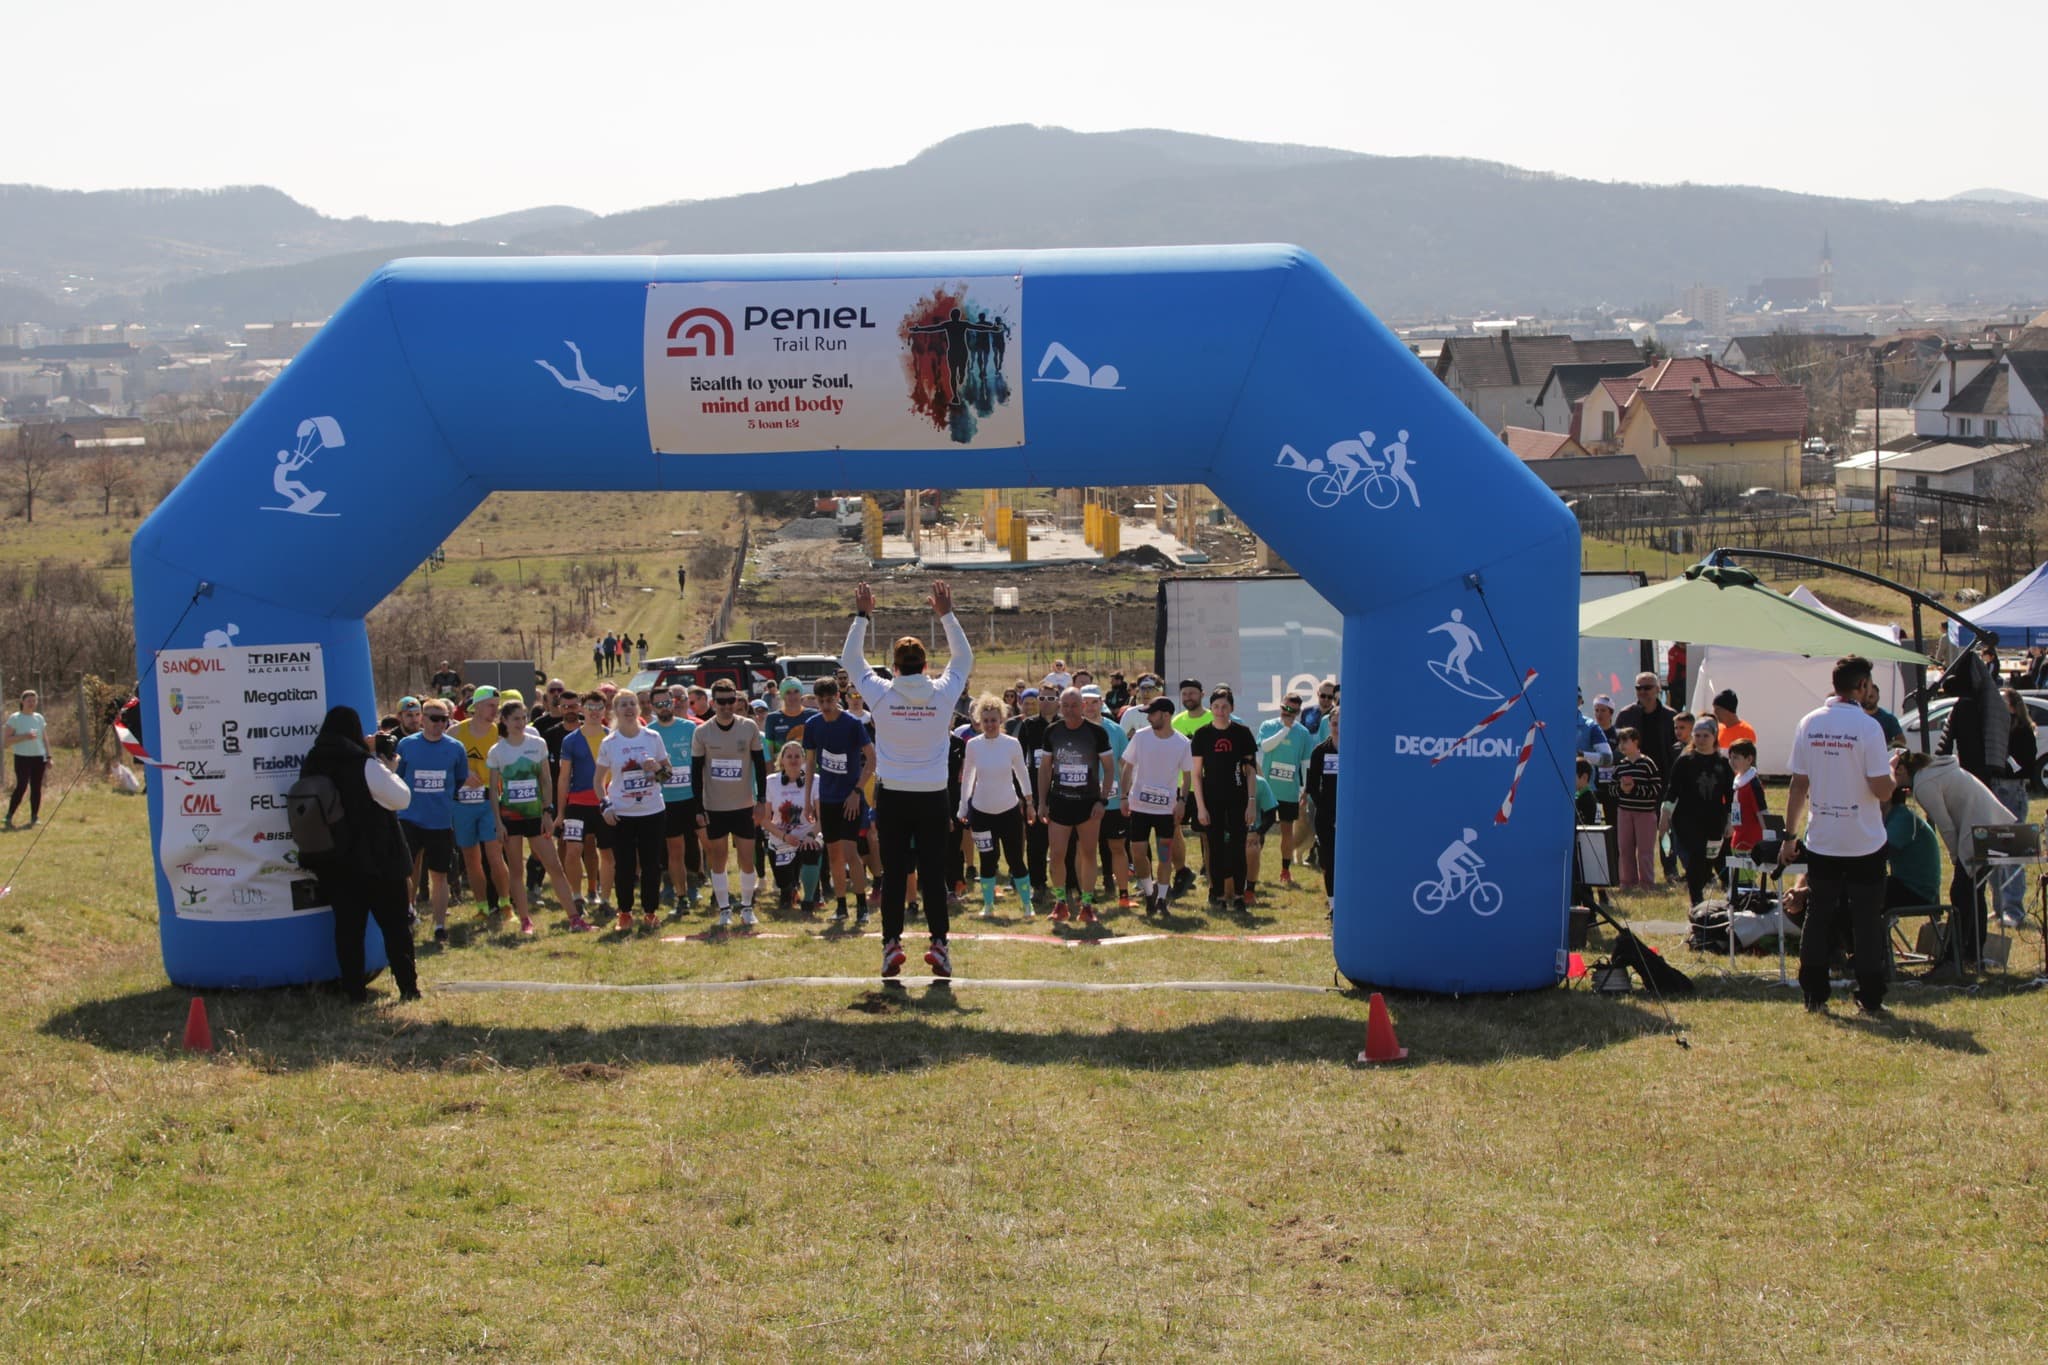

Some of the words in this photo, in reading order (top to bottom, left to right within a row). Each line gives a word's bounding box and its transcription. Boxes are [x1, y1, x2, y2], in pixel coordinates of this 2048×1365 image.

[773, 336, 809, 352] Trail
[815, 336, 847, 351] Run
[690, 375, 742, 391] Health
[747, 376, 763, 390] to
[767, 377, 807, 394] your
[812, 373, 854, 390] Soul,
[701, 396, 750, 414] mind
[754, 396, 790, 413] and
[795, 395, 844, 416] body
[250, 652, 311, 665] TRIFAN
[162, 657, 226, 675] SANOVIL
[244, 688, 318, 706] Megatitan
[269, 724, 319, 738] GUMIX
[1395, 735, 1523, 758] DECATHLON.r
[827, 760, 846, 770] 275
[671, 775, 690, 783] 273
[720, 768, 740, 777] 267
[1067, 774, 1087, 782] 280
[424, 779, 444, 788] 288
[464, 791, 484, 800] 202
[517, 789, 536, 798] 264
[184, 793, 222, 813] CML
[1149, 796, 1167, 806] 223
